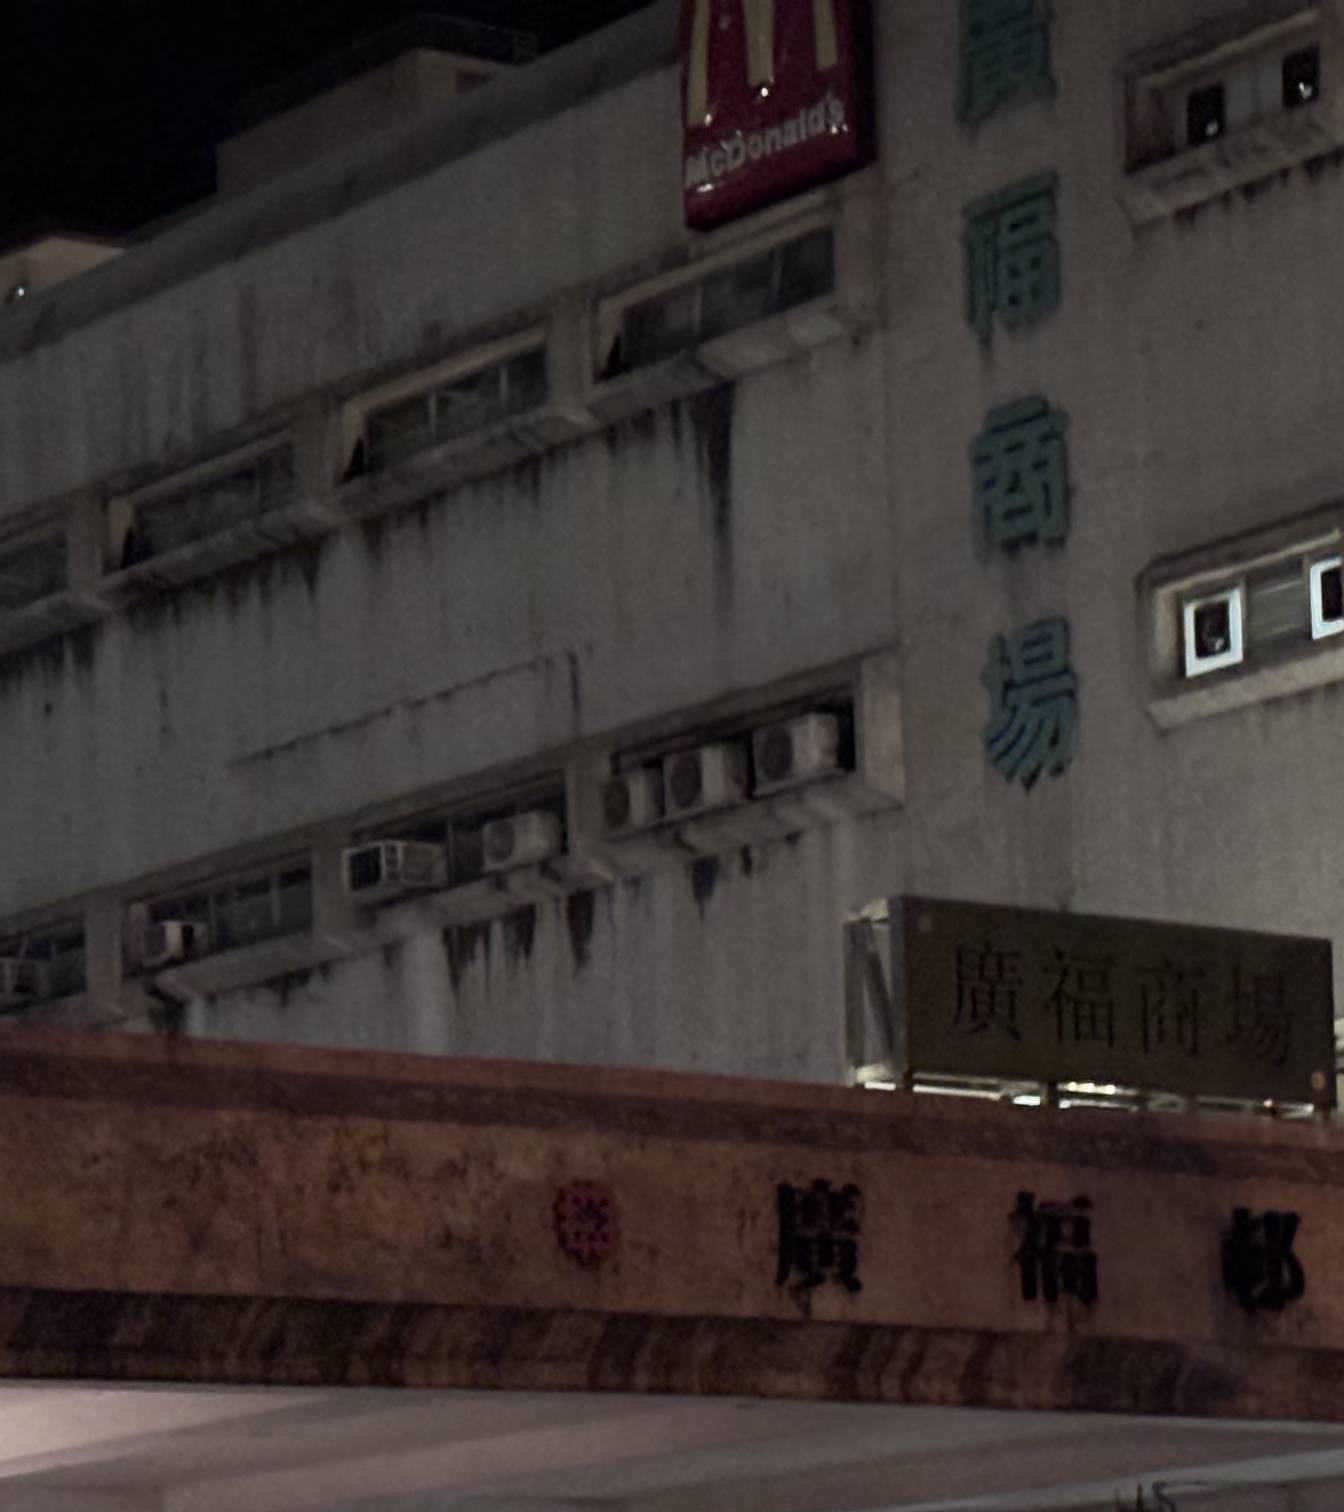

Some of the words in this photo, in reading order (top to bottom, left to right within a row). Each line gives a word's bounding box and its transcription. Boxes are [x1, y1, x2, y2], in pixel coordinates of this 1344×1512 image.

[685, 89, 846, 189] McDonald's
[953, 937, 1296, 1070] 廣福商場
[775, 1180, 1306, 1311] 廣福邨
